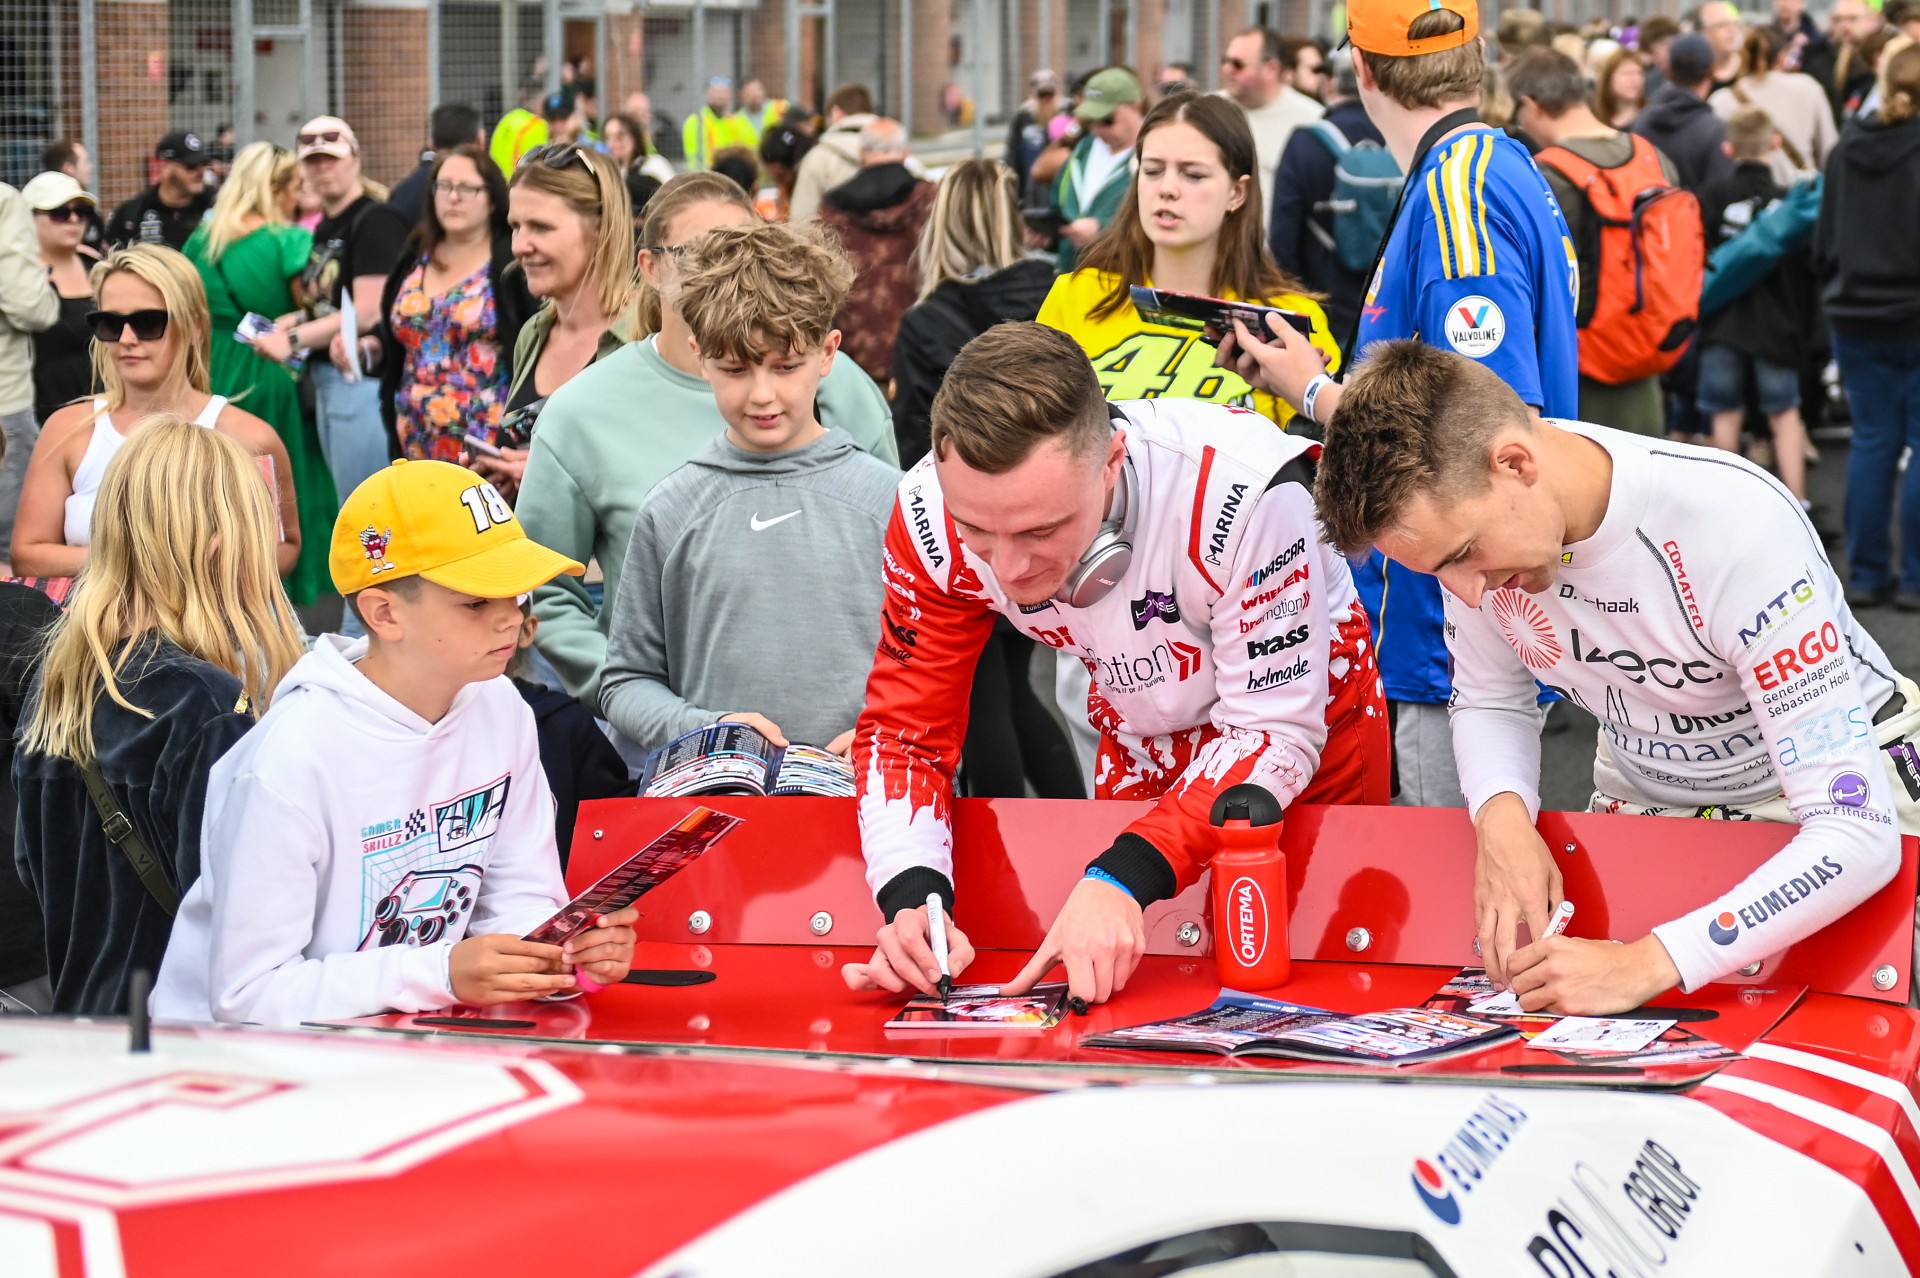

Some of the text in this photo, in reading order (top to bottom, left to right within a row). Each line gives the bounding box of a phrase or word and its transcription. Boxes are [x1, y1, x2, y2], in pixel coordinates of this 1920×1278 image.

[1452, 328, 1496, 343] VALVOLINE
[460, 484, 512, 534] 18
[908, 485, 945, 569] MARINA
[1205, 483, 1249, 566] MARINA
[1258, 537, 1306, 586] NASCAR
[1240, 564, 1310, 610] WHELEN
[1559, 584, 1639, 614] D. haak
[1738, 578, 1814, 648] MTG
[1246, 624, 1309, 660] brass
[1753, 621, 1839, 691] ERGO
[1247, 654, 1311, 691] helmade
[1762, 655, 1845, 704] Generalagentur
[1768, 671, 1850, 718] Sebastian Hold
[361, 819, 400, 837] GAMER
[363, 833, 402, 853] SKILLZ
[1738, 855, 1843, 929] EUMEDIAS
[1237, 885, 1255, 960] ORTEMA
[1623, 1139, 1701, 1239] GROUP
